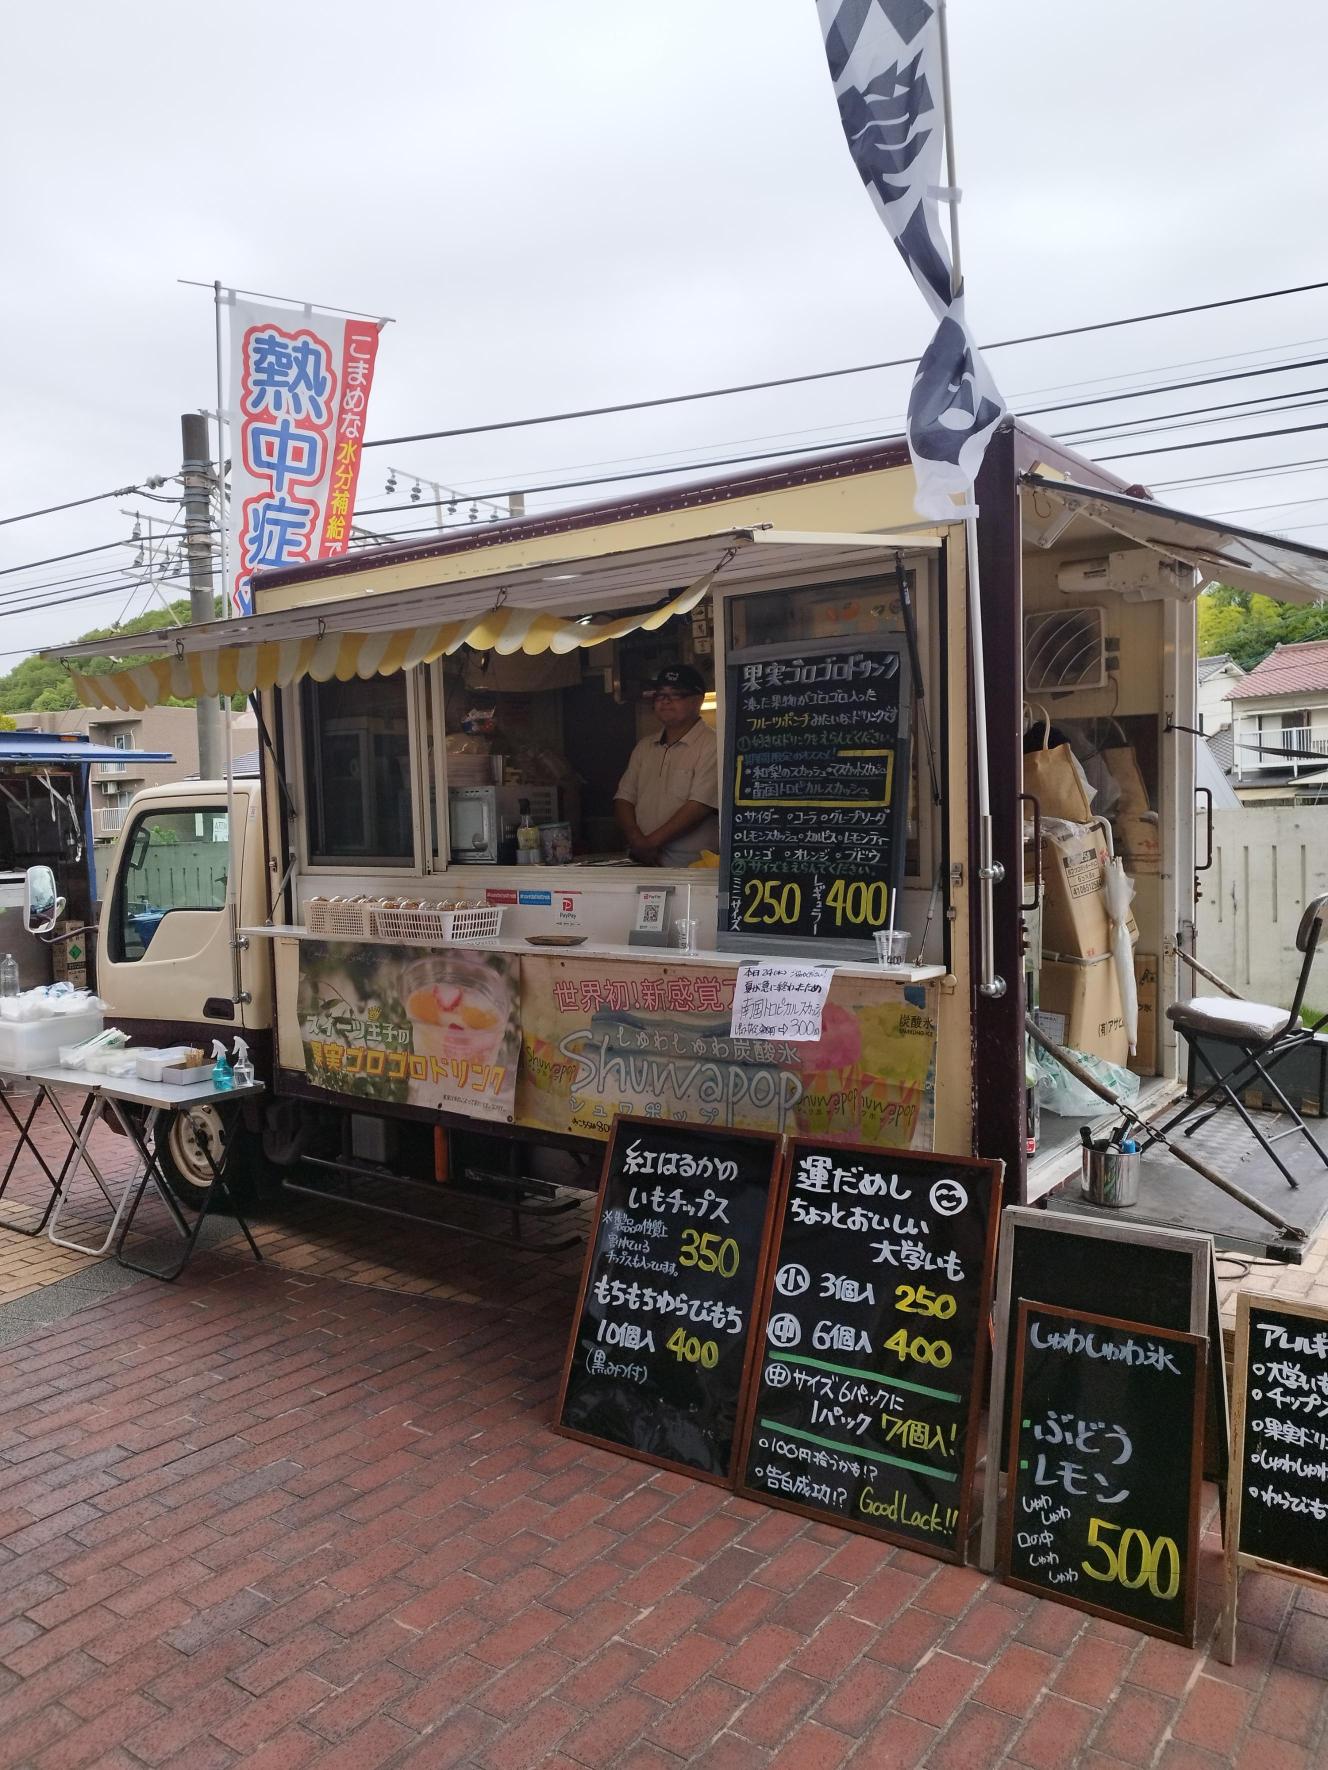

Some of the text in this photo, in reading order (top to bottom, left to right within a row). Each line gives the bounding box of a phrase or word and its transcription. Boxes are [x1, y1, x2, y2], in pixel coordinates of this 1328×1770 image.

[239, 335, 327, 615] 熱中症
[794, 811, 818, 824] コーラ
[744, 880, 801, 924] 250
[826, 880, 887, 926] 400
[306, 1015, 410, 1044] スイーツ王子の
[559, 1029, 803, 1133] Shuwapop
[623, 1139, 738, 1182] 紅はるかの
[795, 1155, 912, 1201] 運だめし
[628, 1186, 730, 1224] いもチップス
[790, 1197, 929, 1236] ちょっとおいしい
[608, 1232, 650, 1253] 割れている
[678, 1229, 740, 1278] 350
[870, 1242, 965, 1281] 大学いも
[593, 1274, 743, 1334] もちもちわらびもち
[819, 1272, 876, 1305] 3個入
[895, 1284, 957, 1320] 250
[597, 1319, 655, 1352] 10個入
[666, 1327, 718, 1369] 400
[812, 1320, 872, 1354] 6個入
[883, 1328, 952, 1369] 400
[1030, 1323, 1181, 1375] しゅわしゅわ氷
[1034, 1411, 1132, 1465] ぶどう
[1264, 1417, 1328, 1450] 果実ドリ
[1035, 1454, 1130, 1503] レモン
[859, 1486, 899, 1523] Good
[1022, 1494, 1052, 1512] しゅわ
[1041, 1506, 1070, 1526] しゅわ
[1017, 1530, 1054, 1548] 口の中
[1029, 1552, 1059, 1567] しゅわ
[1081, 1517, 1180, 1600] 500
[1048, 1568, 1078, 1584] しゅわ
